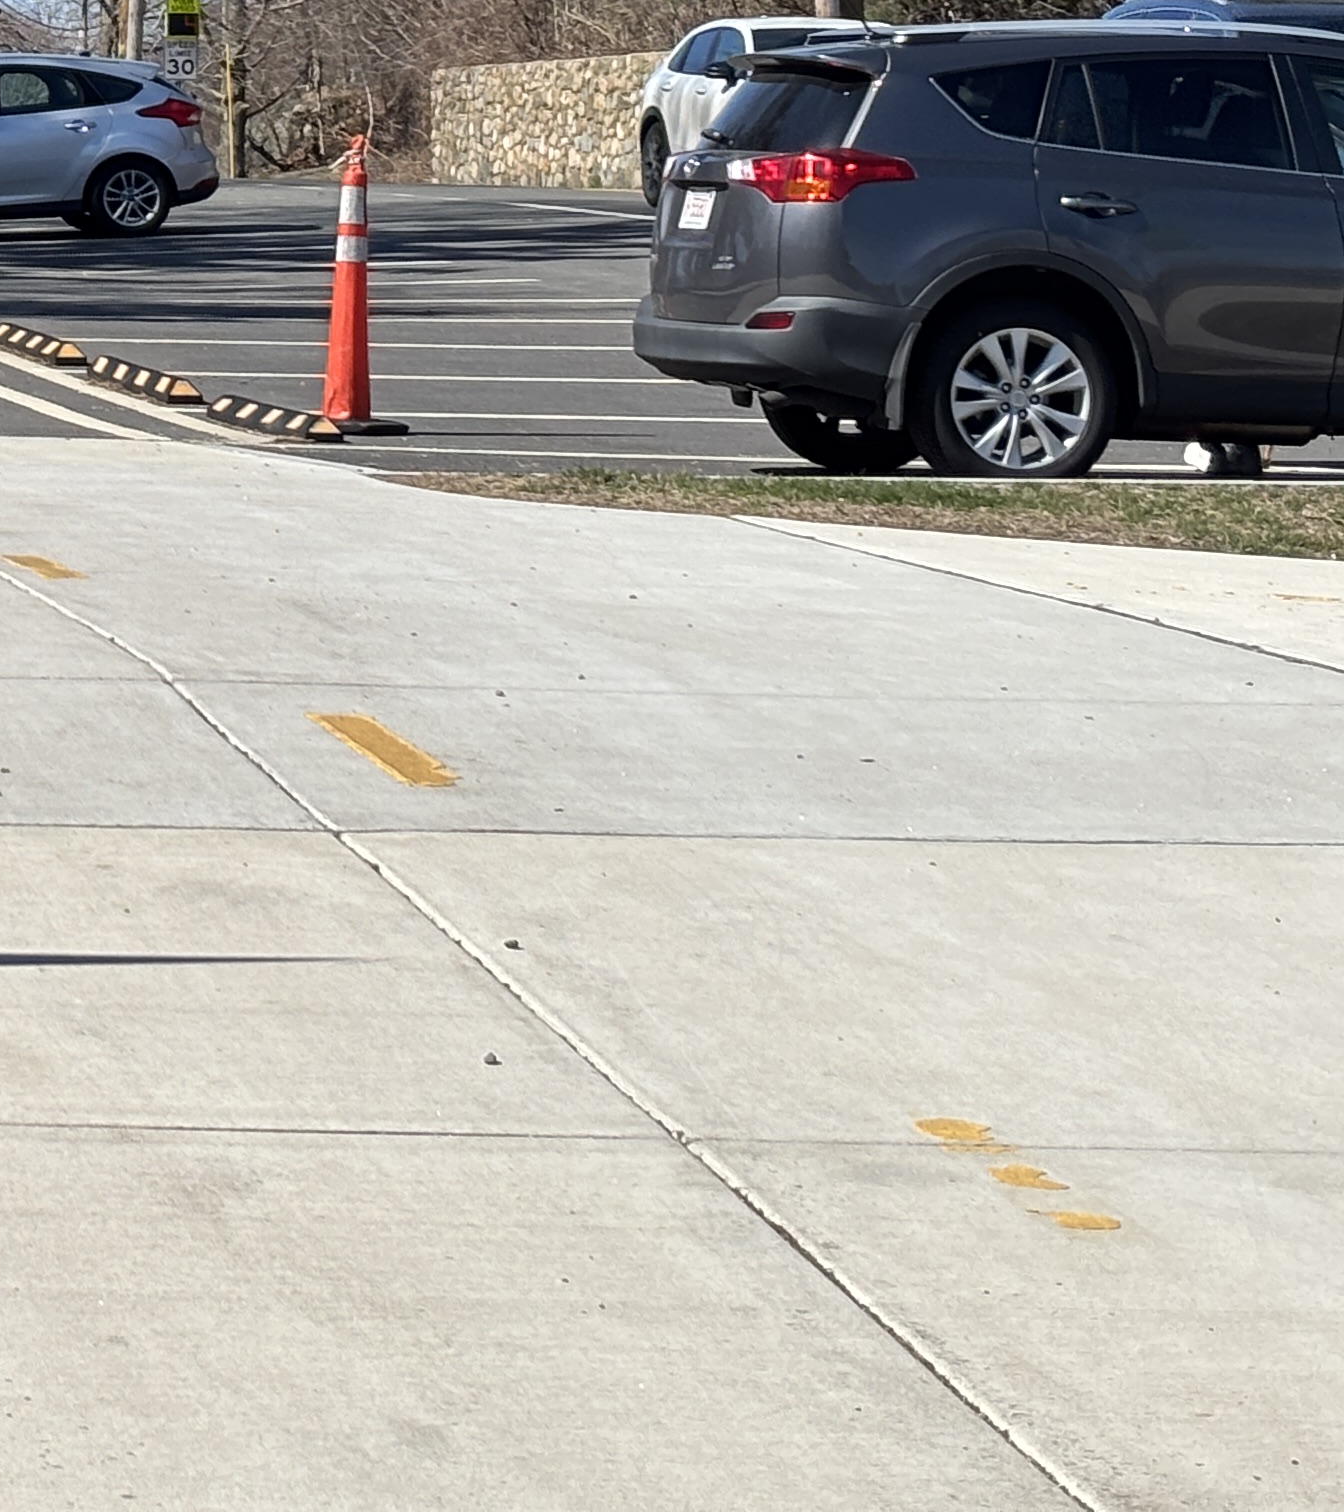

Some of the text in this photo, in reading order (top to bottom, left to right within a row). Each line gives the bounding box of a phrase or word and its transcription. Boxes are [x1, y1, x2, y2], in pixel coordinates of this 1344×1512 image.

[167, 40, 196, 48] SPEED
[169, 49, 192, 57] LIMIT
[166, 58, 195, 75] 30
